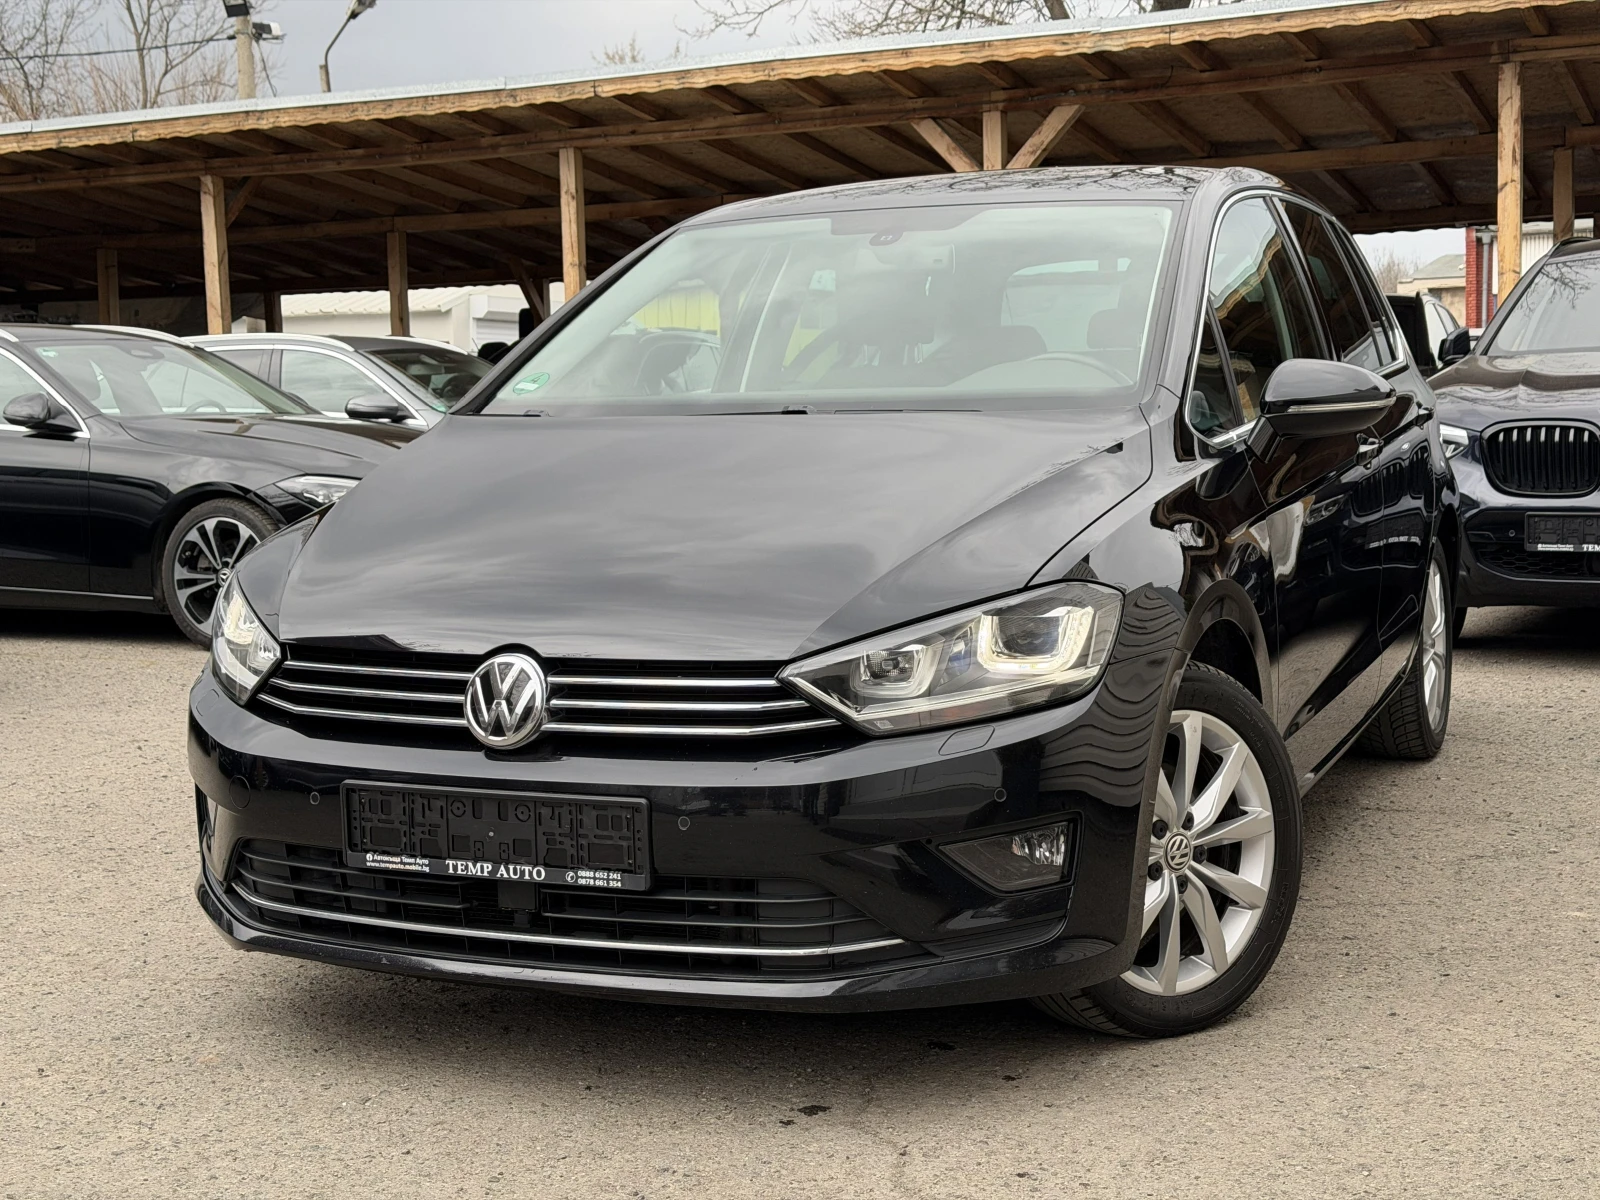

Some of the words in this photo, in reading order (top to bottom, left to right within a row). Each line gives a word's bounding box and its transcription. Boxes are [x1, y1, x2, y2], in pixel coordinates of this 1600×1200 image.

[466, 655, 543, 747] VW
[366, 861, 430, 872] www.tempauto.mobile.bg
[445, 860, 493, 876] TEMP
[496, 864, 546, 881] AUTO
[577, 870, 594, 878] 0888
[595, 871, 608, 879] 652
[608, 872, 622, 880] 241
[595, 879, 608, 887] 661
[608, 880, 622, 888] 354
